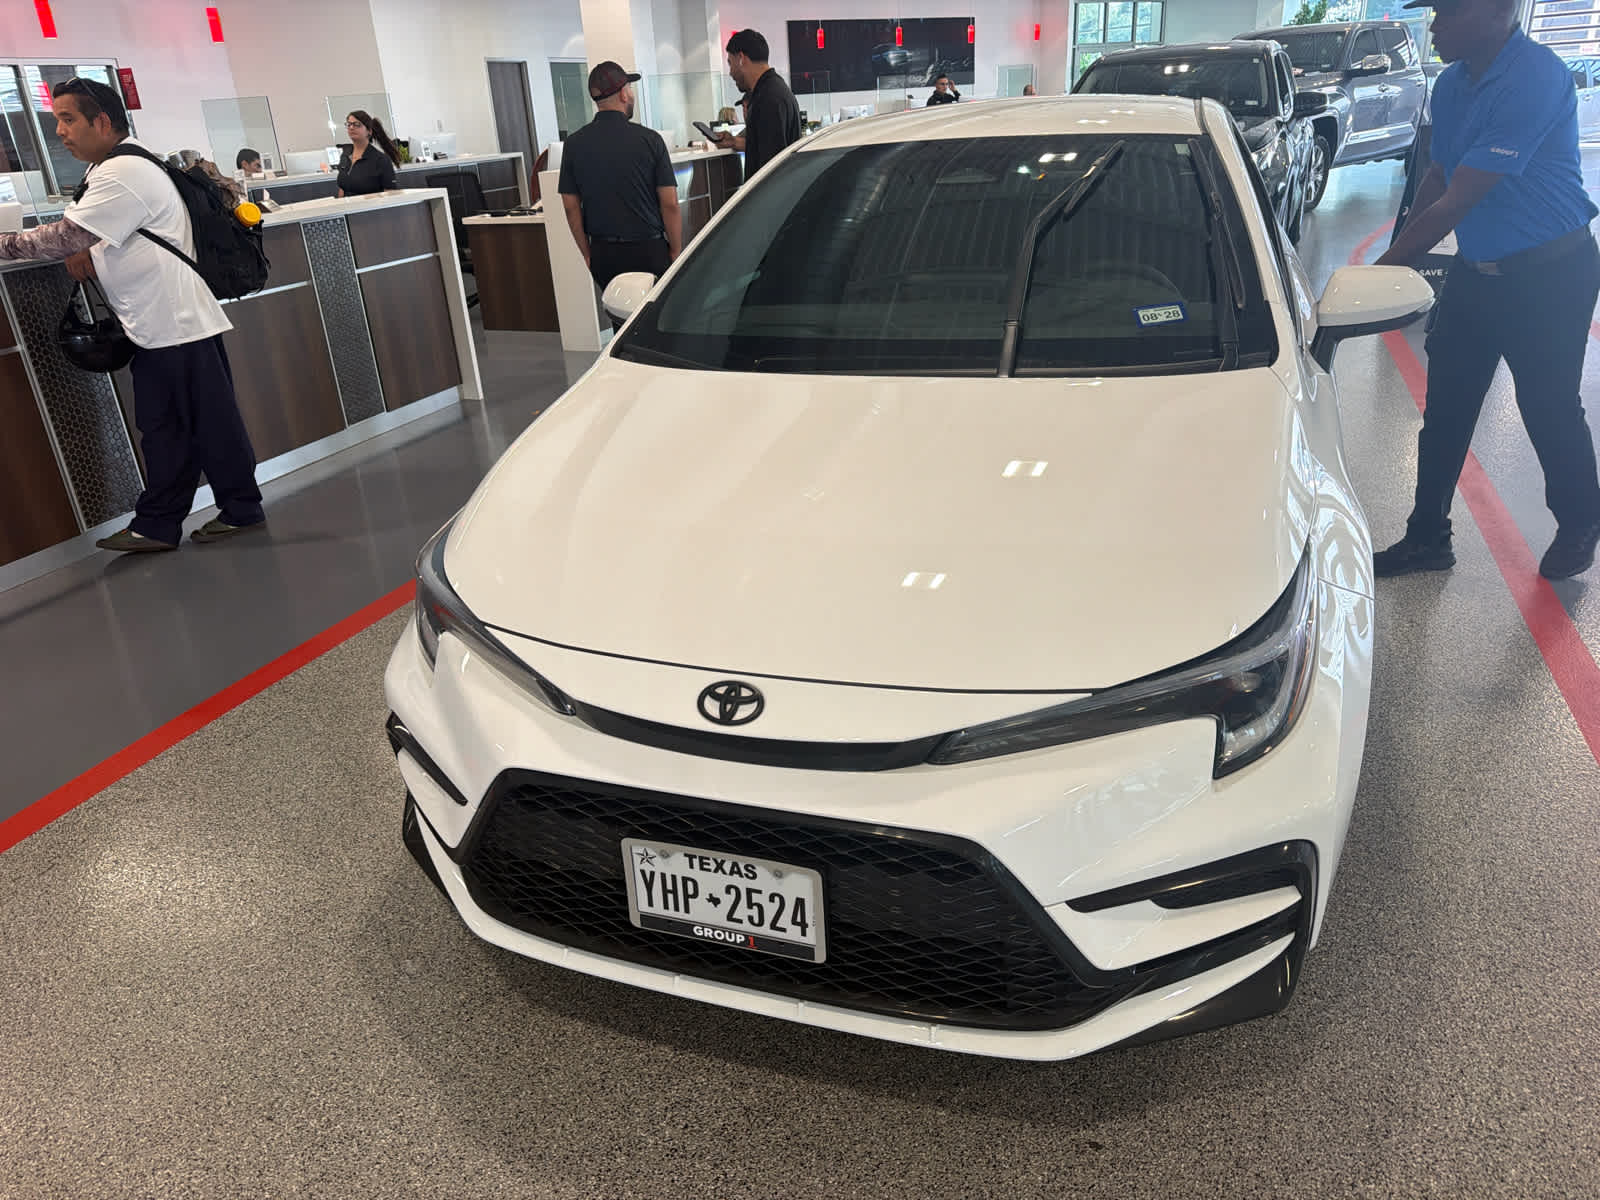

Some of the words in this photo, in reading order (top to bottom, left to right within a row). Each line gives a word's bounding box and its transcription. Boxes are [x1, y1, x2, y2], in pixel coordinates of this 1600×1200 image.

[1419, 268, 1443, 276] SAVE
[1142, 313, 1158, 321] 08
[1164, 311, 1180, 319] 28
[684, 853, 757, 880] TEXAS
[640, 869, 699, 914] YHP
[725, 884, 809, 937] 2524
[693, 926, 745, 944] GROUP
